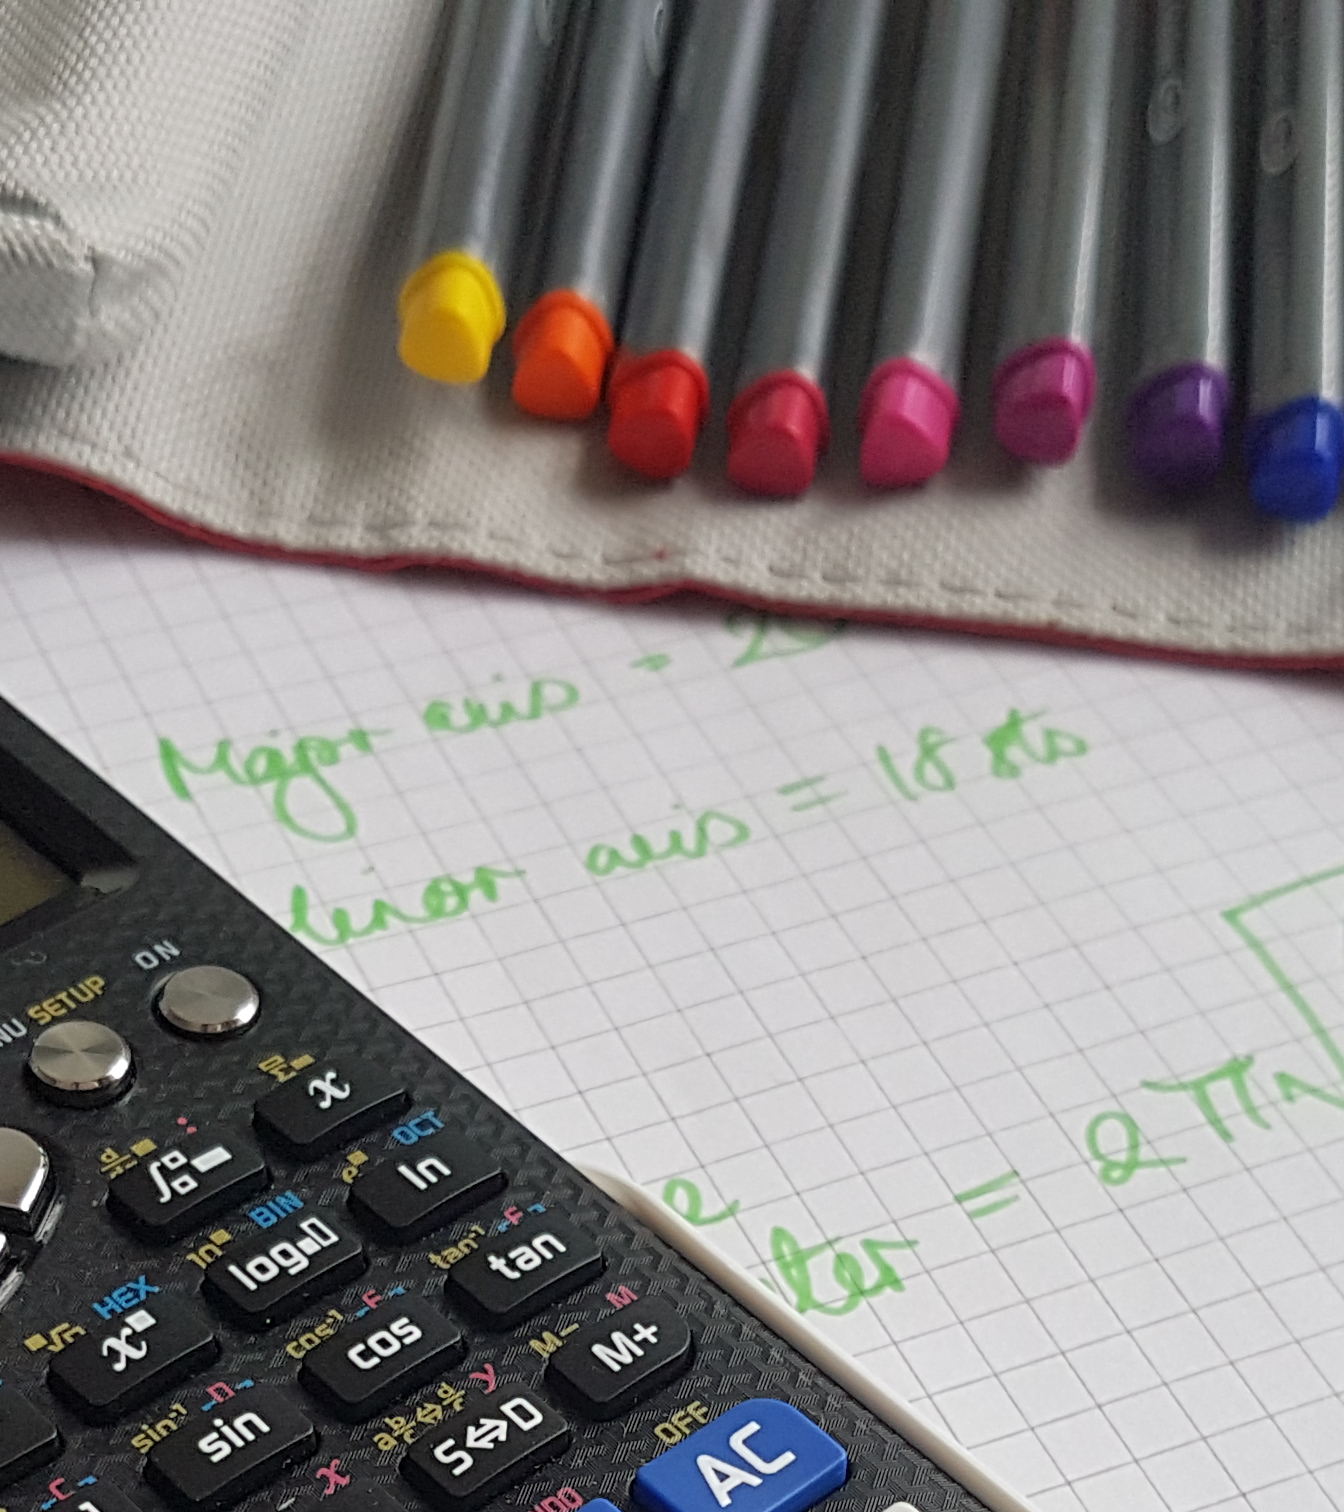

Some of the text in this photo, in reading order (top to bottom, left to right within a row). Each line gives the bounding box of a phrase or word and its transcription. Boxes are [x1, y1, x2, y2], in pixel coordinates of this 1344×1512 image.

[131, 938, 182, 971] ON
[26, 975, 107, 1026] SETUP
[308, 1070, 351, 1110] x
[390, 1110, 446, 1145] OCT
[248, 1191, 305, 1230] BIN
[487, 1230, 568, 1282] tan
[92, 1274, 160, 1321] HEX
[346, 1314, 424, 1372] cos
[589, 1320, 660, 1374] M+
[196, 1411, 272, 1465] sin
[653, 1400, 712, 1445] OFF
[695, 1420, 798, 1509] AC
